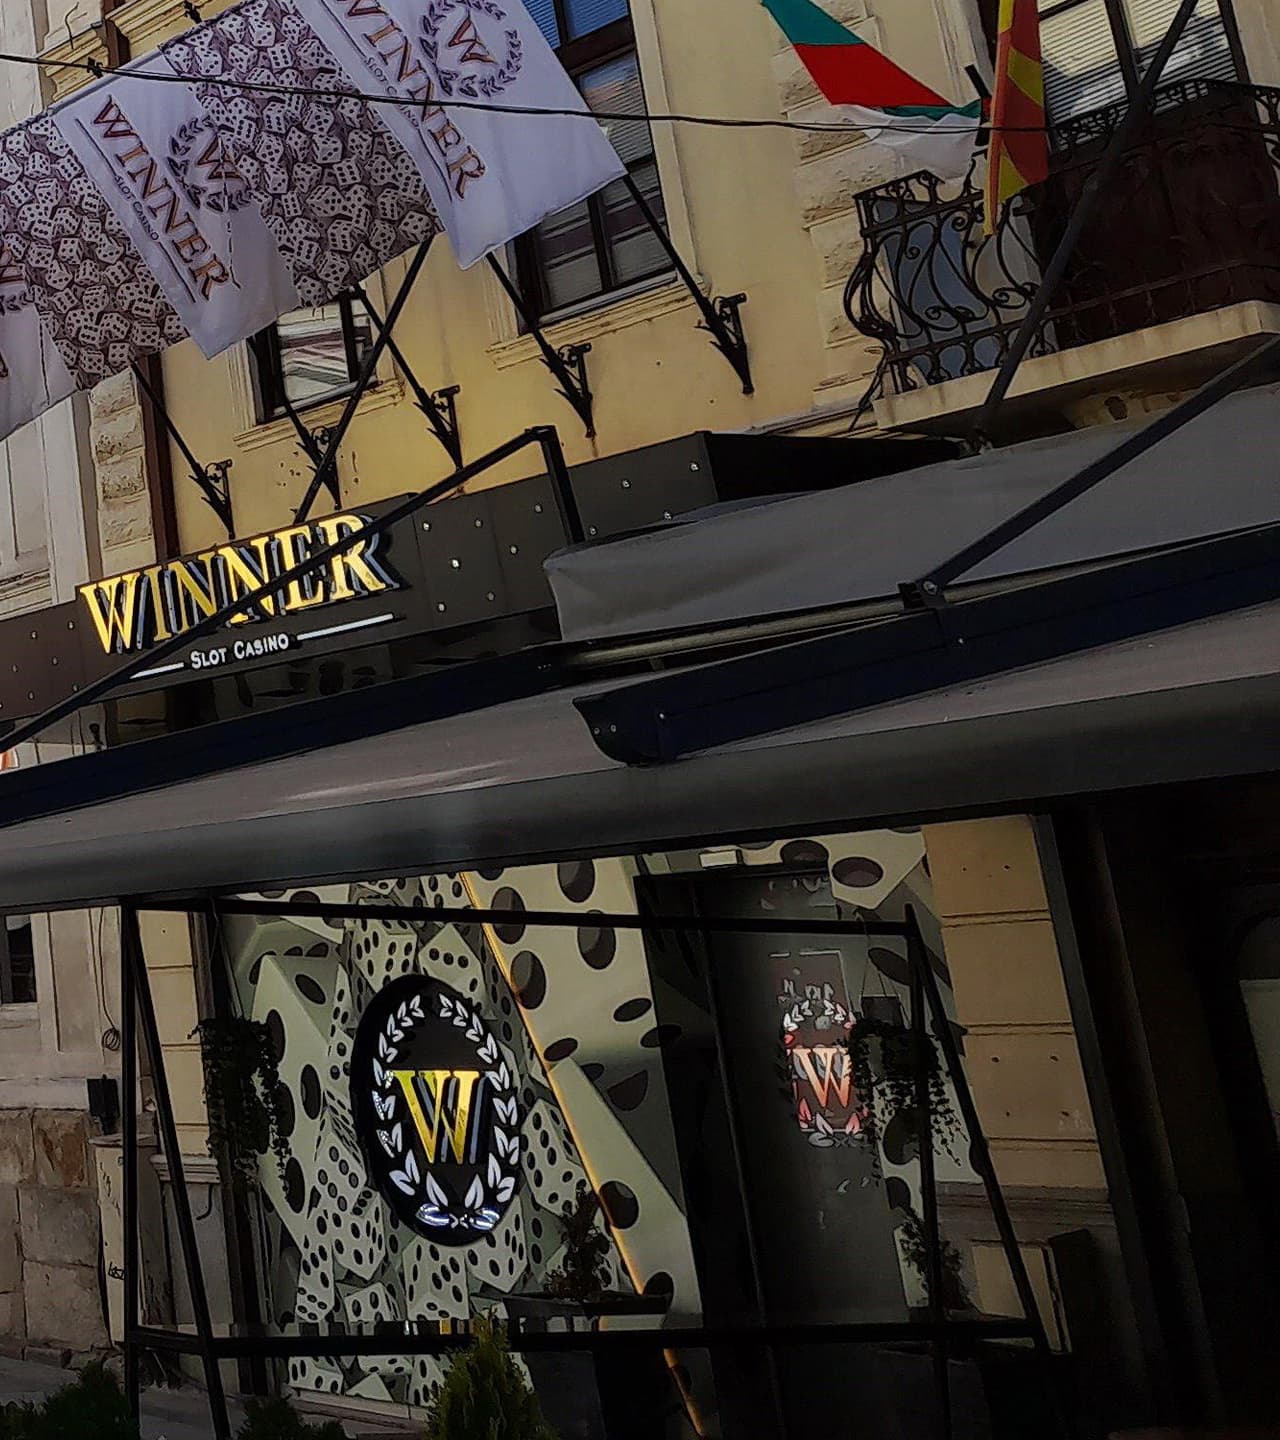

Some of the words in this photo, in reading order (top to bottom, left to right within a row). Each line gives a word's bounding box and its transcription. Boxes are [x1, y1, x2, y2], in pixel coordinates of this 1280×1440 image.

[364, 56, 388, 84] SLOT
[92, 94, 230, 302] WINNER
[114, 174, 133, 200] SLOT
[131, 201, 160, 241] CASINO
[79, 513, 392, 654] WINNER
[189, 647, 227, 669] SLOT
[233, 633, 290, 659] CASINO
